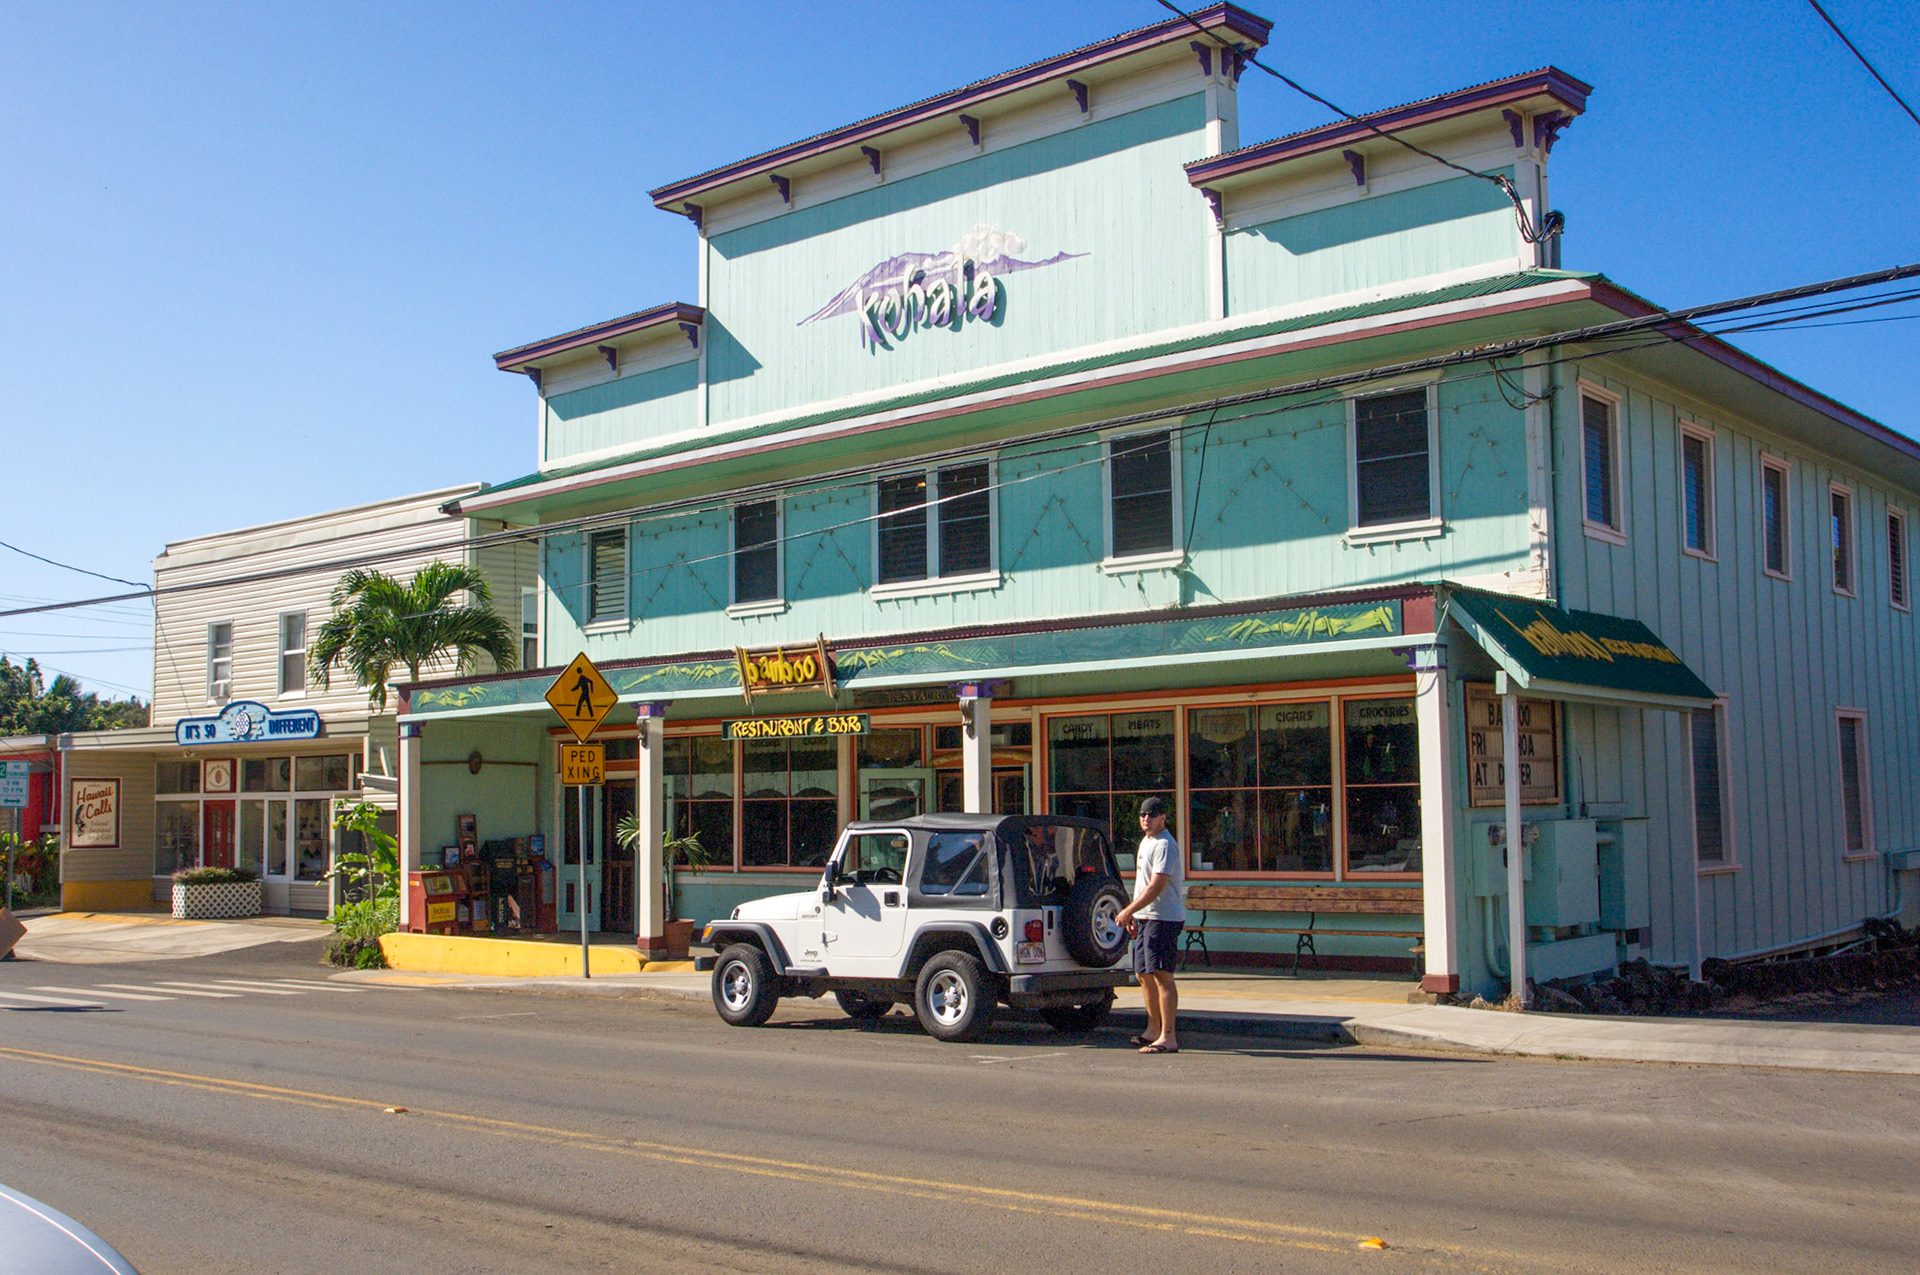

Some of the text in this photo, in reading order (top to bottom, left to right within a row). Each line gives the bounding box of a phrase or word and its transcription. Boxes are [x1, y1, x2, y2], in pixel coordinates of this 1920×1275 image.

[743, 647, 816, 686] bamboo
[1276, 710, 1314, 723] CIGARS
[1360, 706, 1410, 718] GROCERIES
[1488, 703, 1531, 727] BAOO
[185, 717, 316, 740] IT'S SO DIFFERENT
[731, 715, 862, 739] RESTAURANT & BAR
[1063, 722, 1095, 734] CANDY
[1128, 719, 1161, 730] MEATS
[571, 751, 596, 763] PED
[568, 766, 600, 780] XING
[1475, 763, 1487, 786] AT
[76, 786, 114, 805] Hawaii
[86, 799, 112, 819] Calls
[804, 949, 818, 958] Jeep
